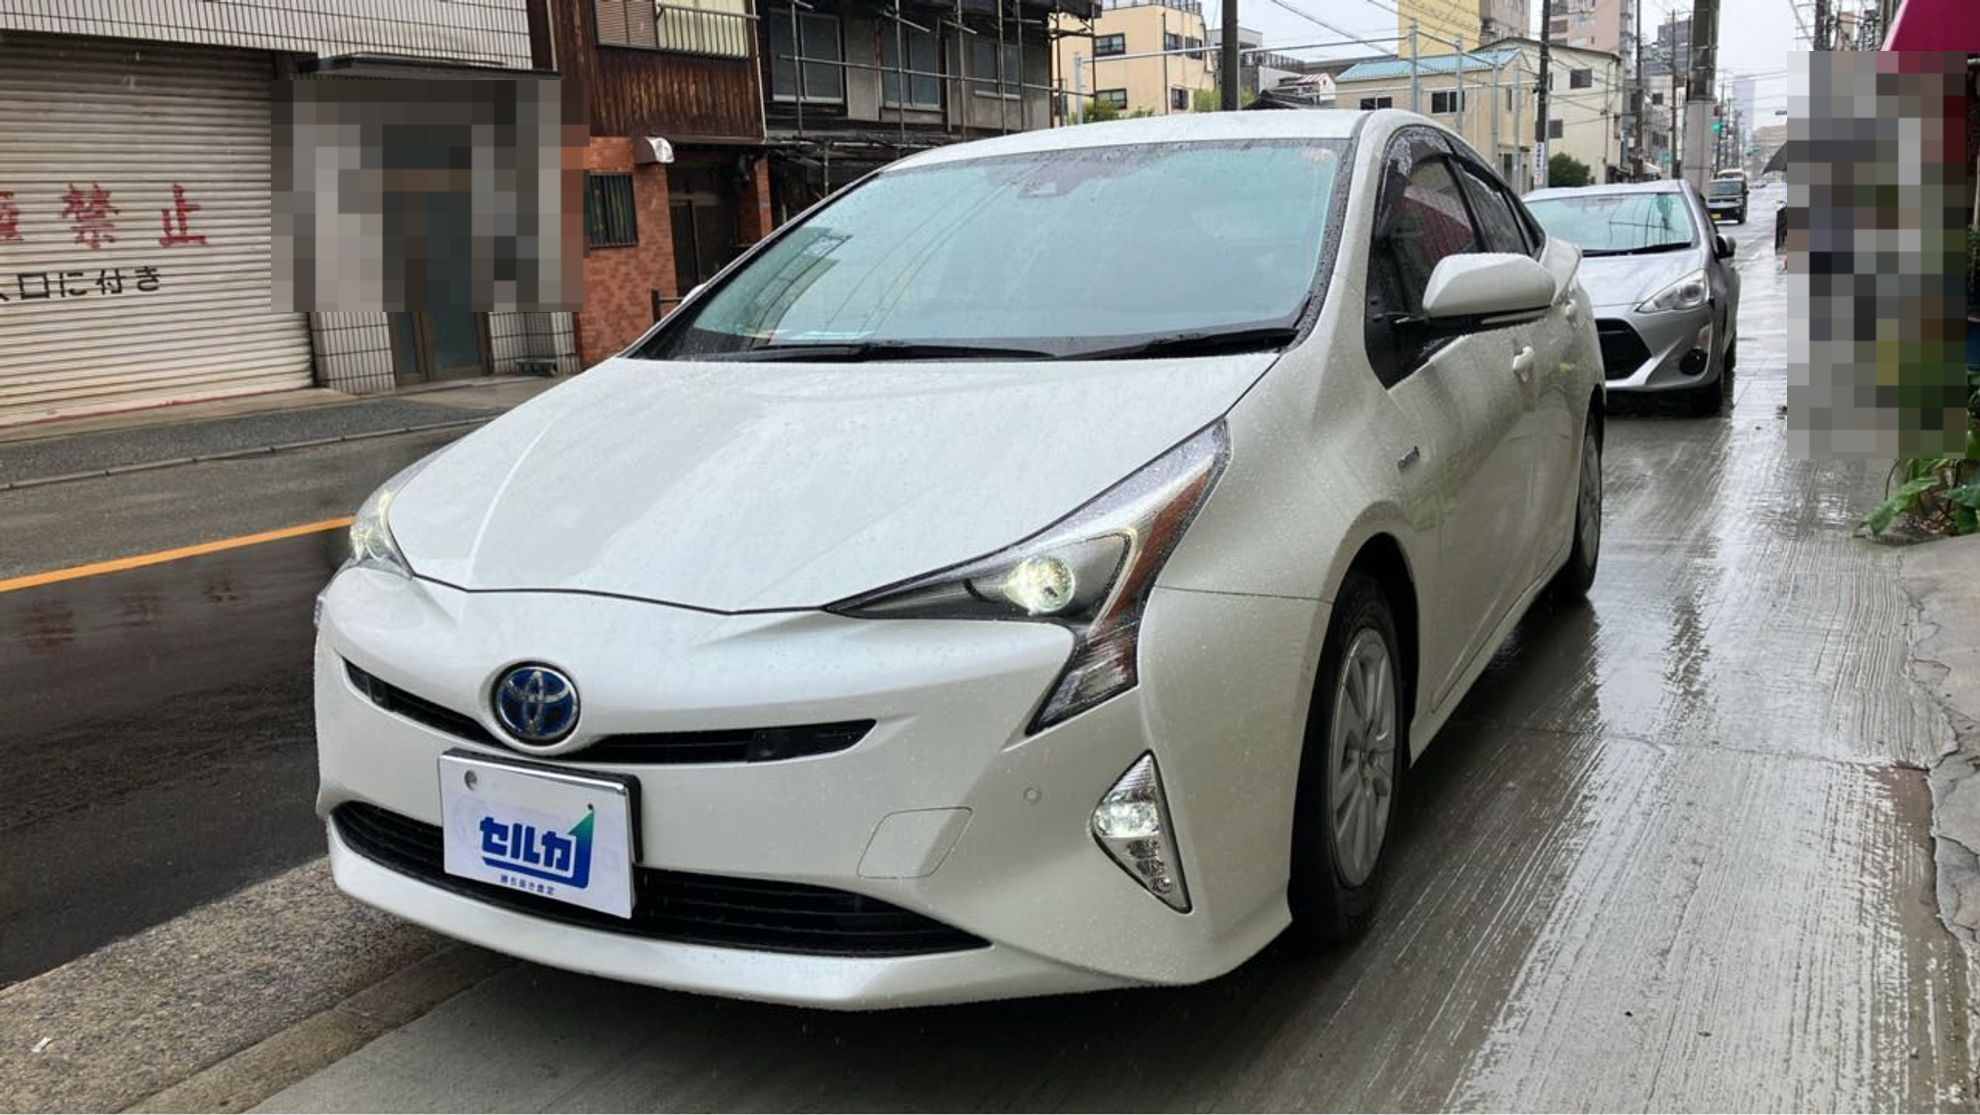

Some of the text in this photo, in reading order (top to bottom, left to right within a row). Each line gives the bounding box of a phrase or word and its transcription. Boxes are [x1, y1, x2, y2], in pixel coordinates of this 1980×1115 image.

[0, 266, 161, 300] 口に付き
[480, 816, 572, 872] セルカ
